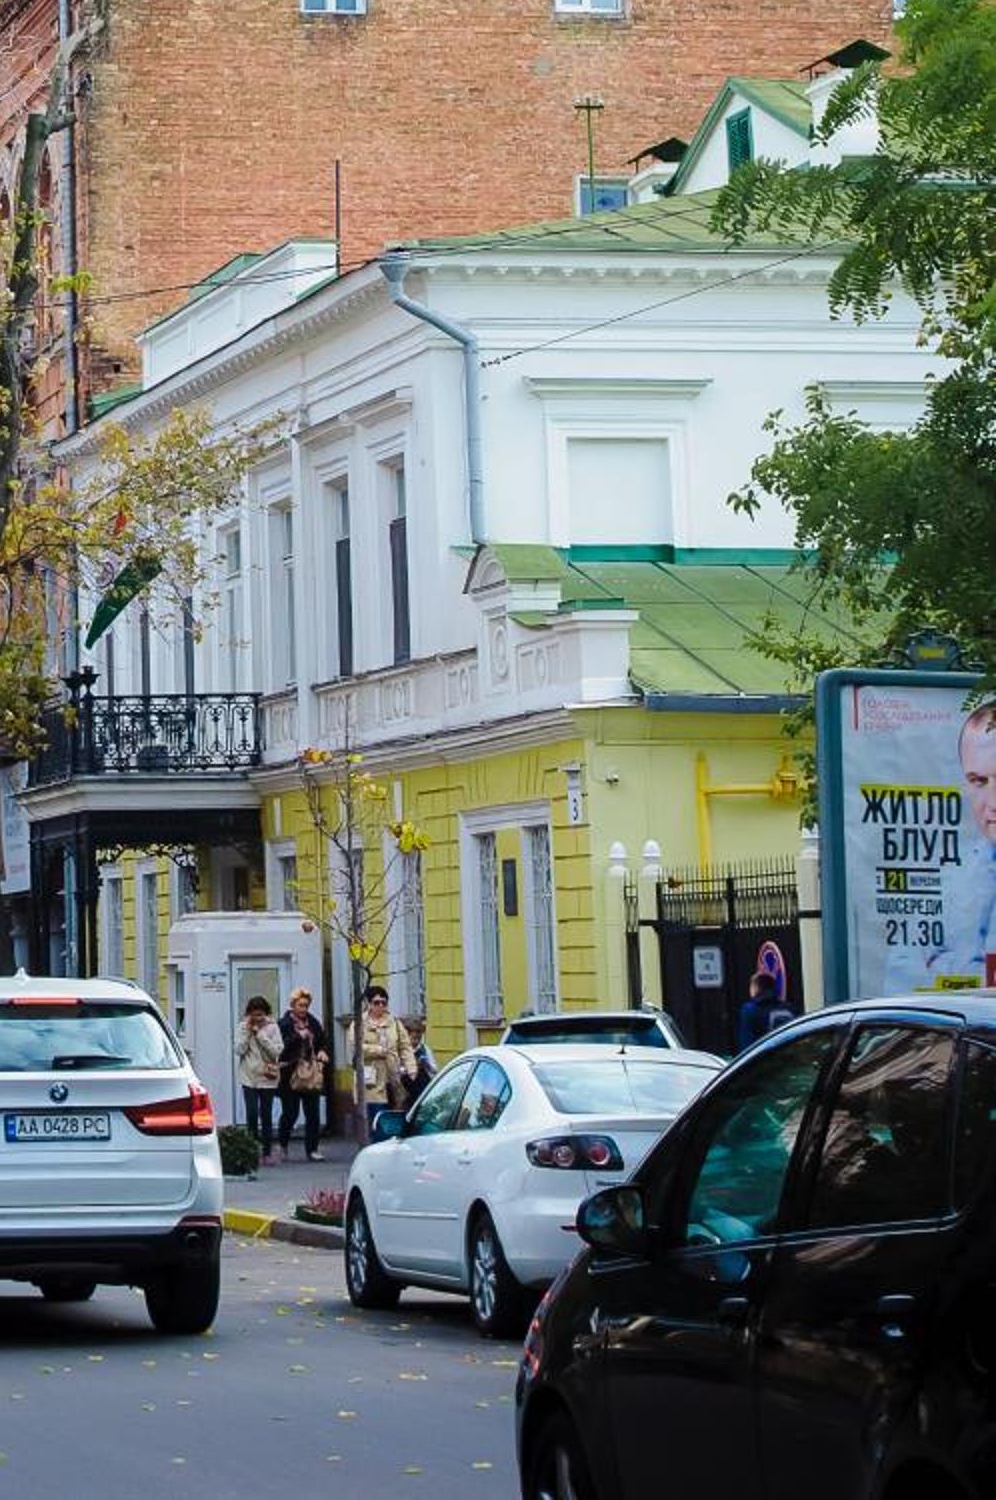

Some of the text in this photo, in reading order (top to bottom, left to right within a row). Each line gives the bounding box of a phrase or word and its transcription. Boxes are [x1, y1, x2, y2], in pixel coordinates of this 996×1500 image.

[861, 789, 961, 826] ЖИТЛО
[883, 827, 961, 866] БЛУД
[887, 872, 904, 890] 21
[876, 898, 943, 916] ЩОСЕРЕДИ
[886, 920, 944, 946] 21.30
[17, 1117, 105, 1135] AA 0428 PC
